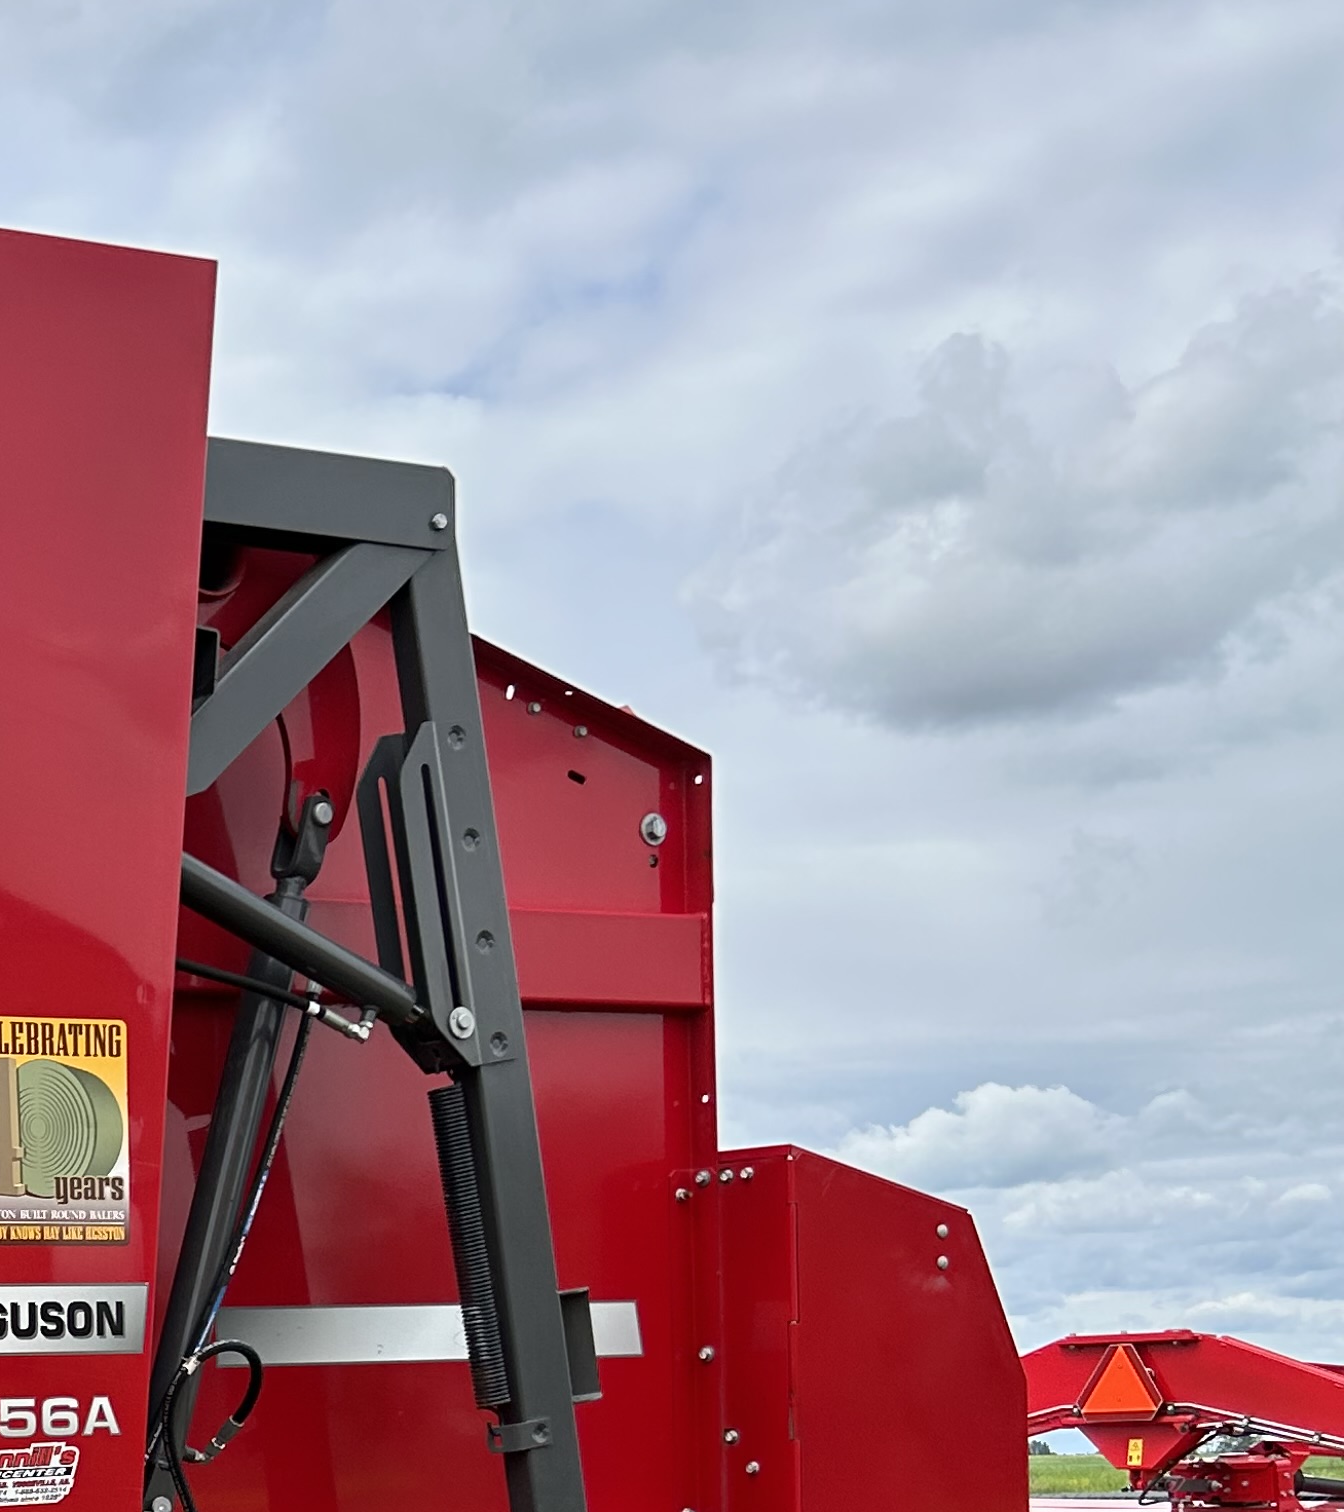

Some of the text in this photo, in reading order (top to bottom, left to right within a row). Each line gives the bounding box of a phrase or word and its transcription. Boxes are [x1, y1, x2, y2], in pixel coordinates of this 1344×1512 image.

[54, 1175, 125, 1205] years
[20, 1209, 48, 1220] BUILT
[50, 1209, 87, 1220] ROUND
